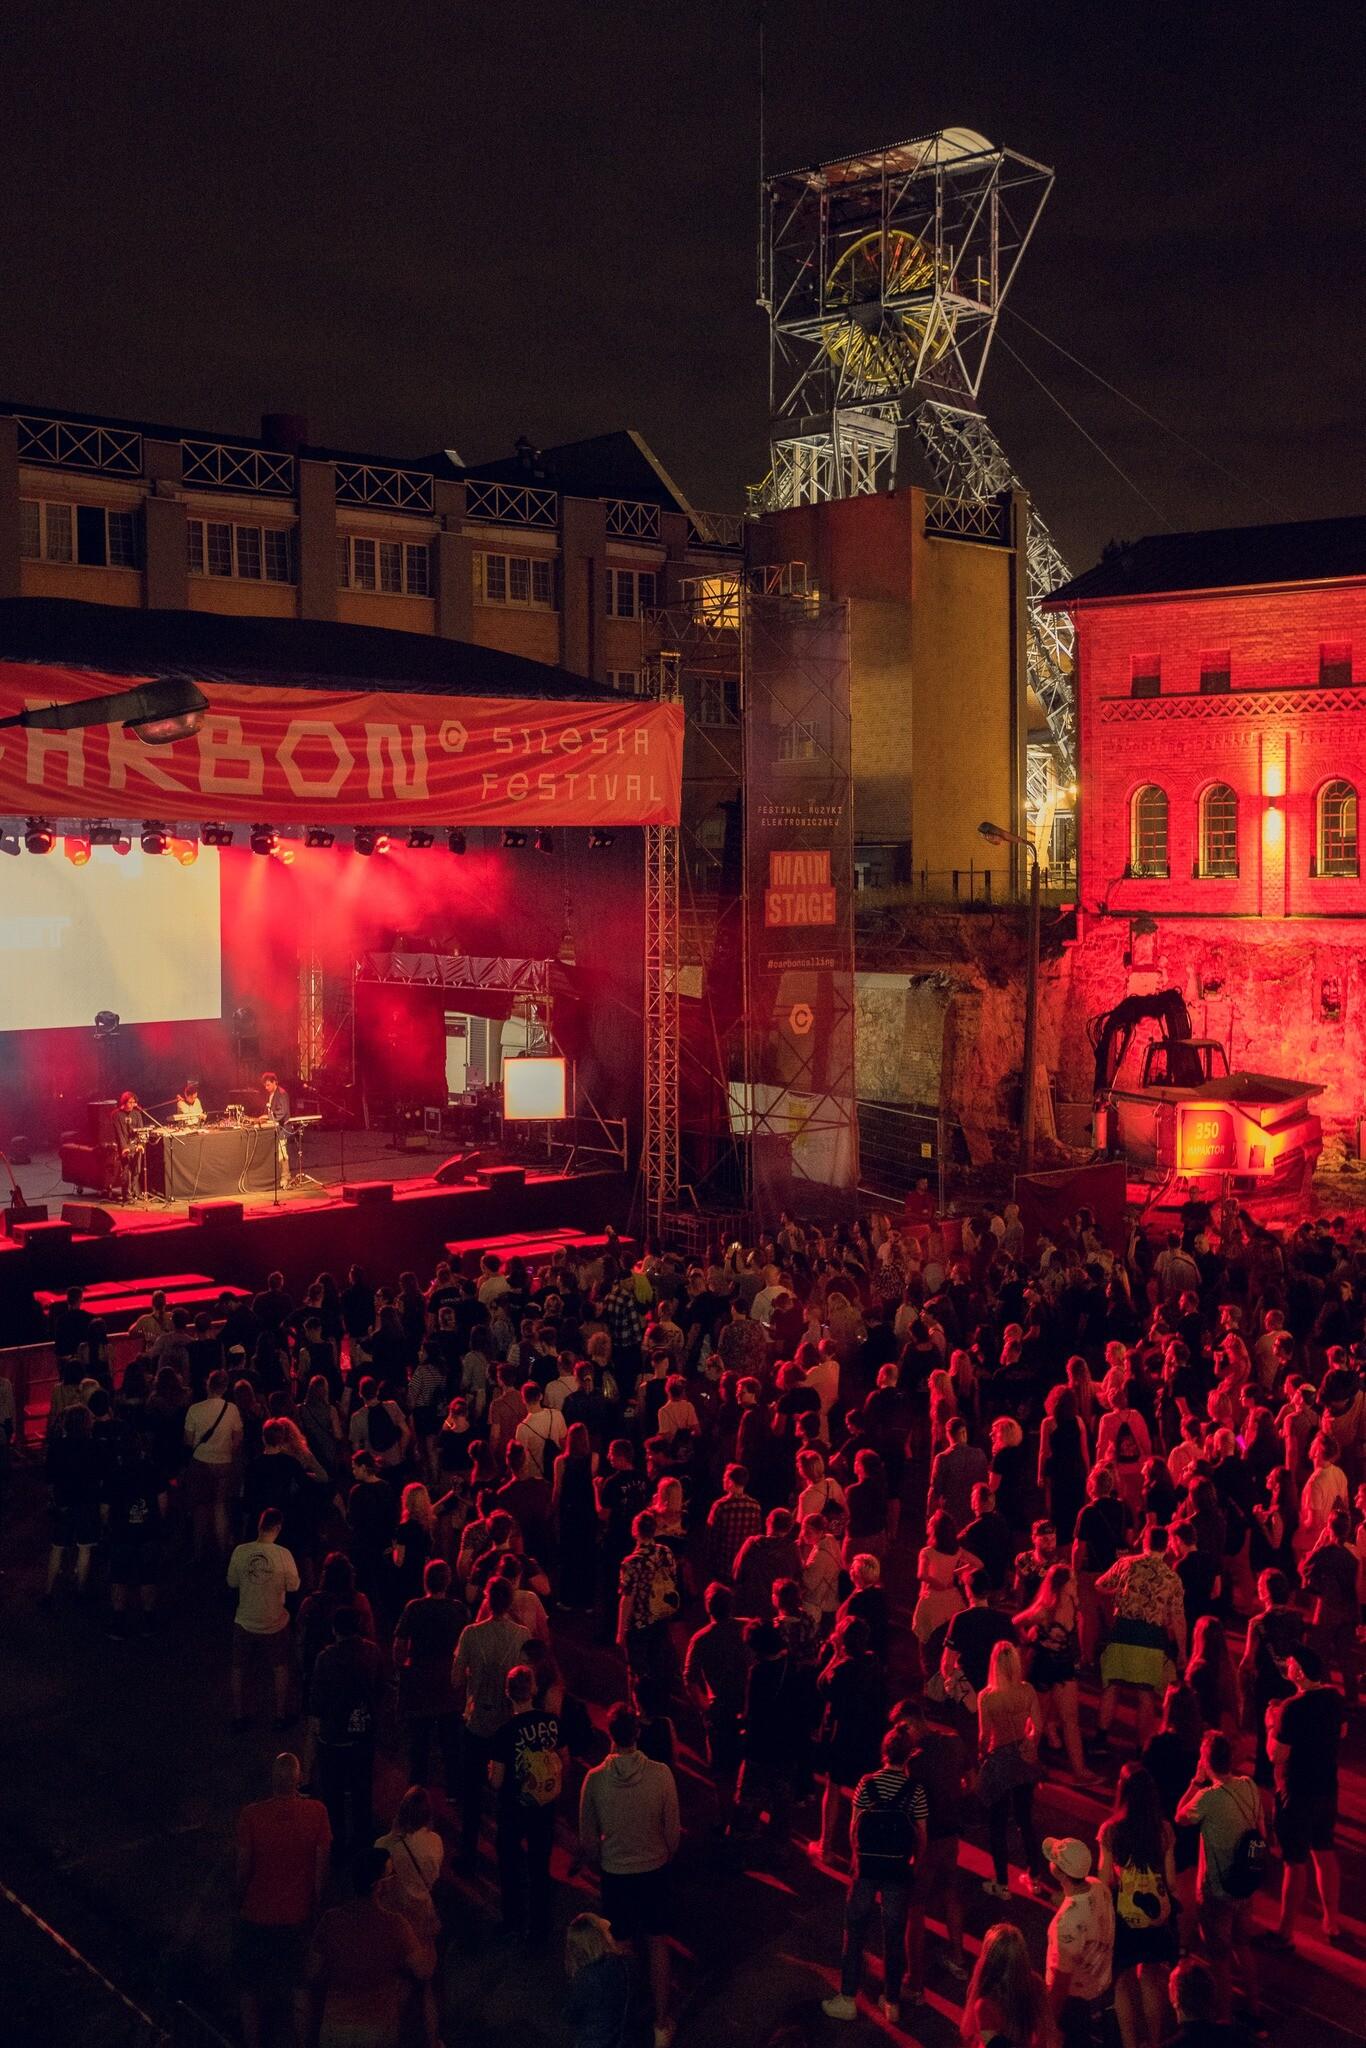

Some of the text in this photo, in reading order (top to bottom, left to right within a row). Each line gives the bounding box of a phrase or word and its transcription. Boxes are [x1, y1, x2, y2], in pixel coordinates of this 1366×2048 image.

[0, 698, 430, 800] ARBON
[761, 818, 840, 826] ELEKTRONICZNEJ
[773, 854, 828, 885] MAIN
[769, 892, 834, 924] STAGE
